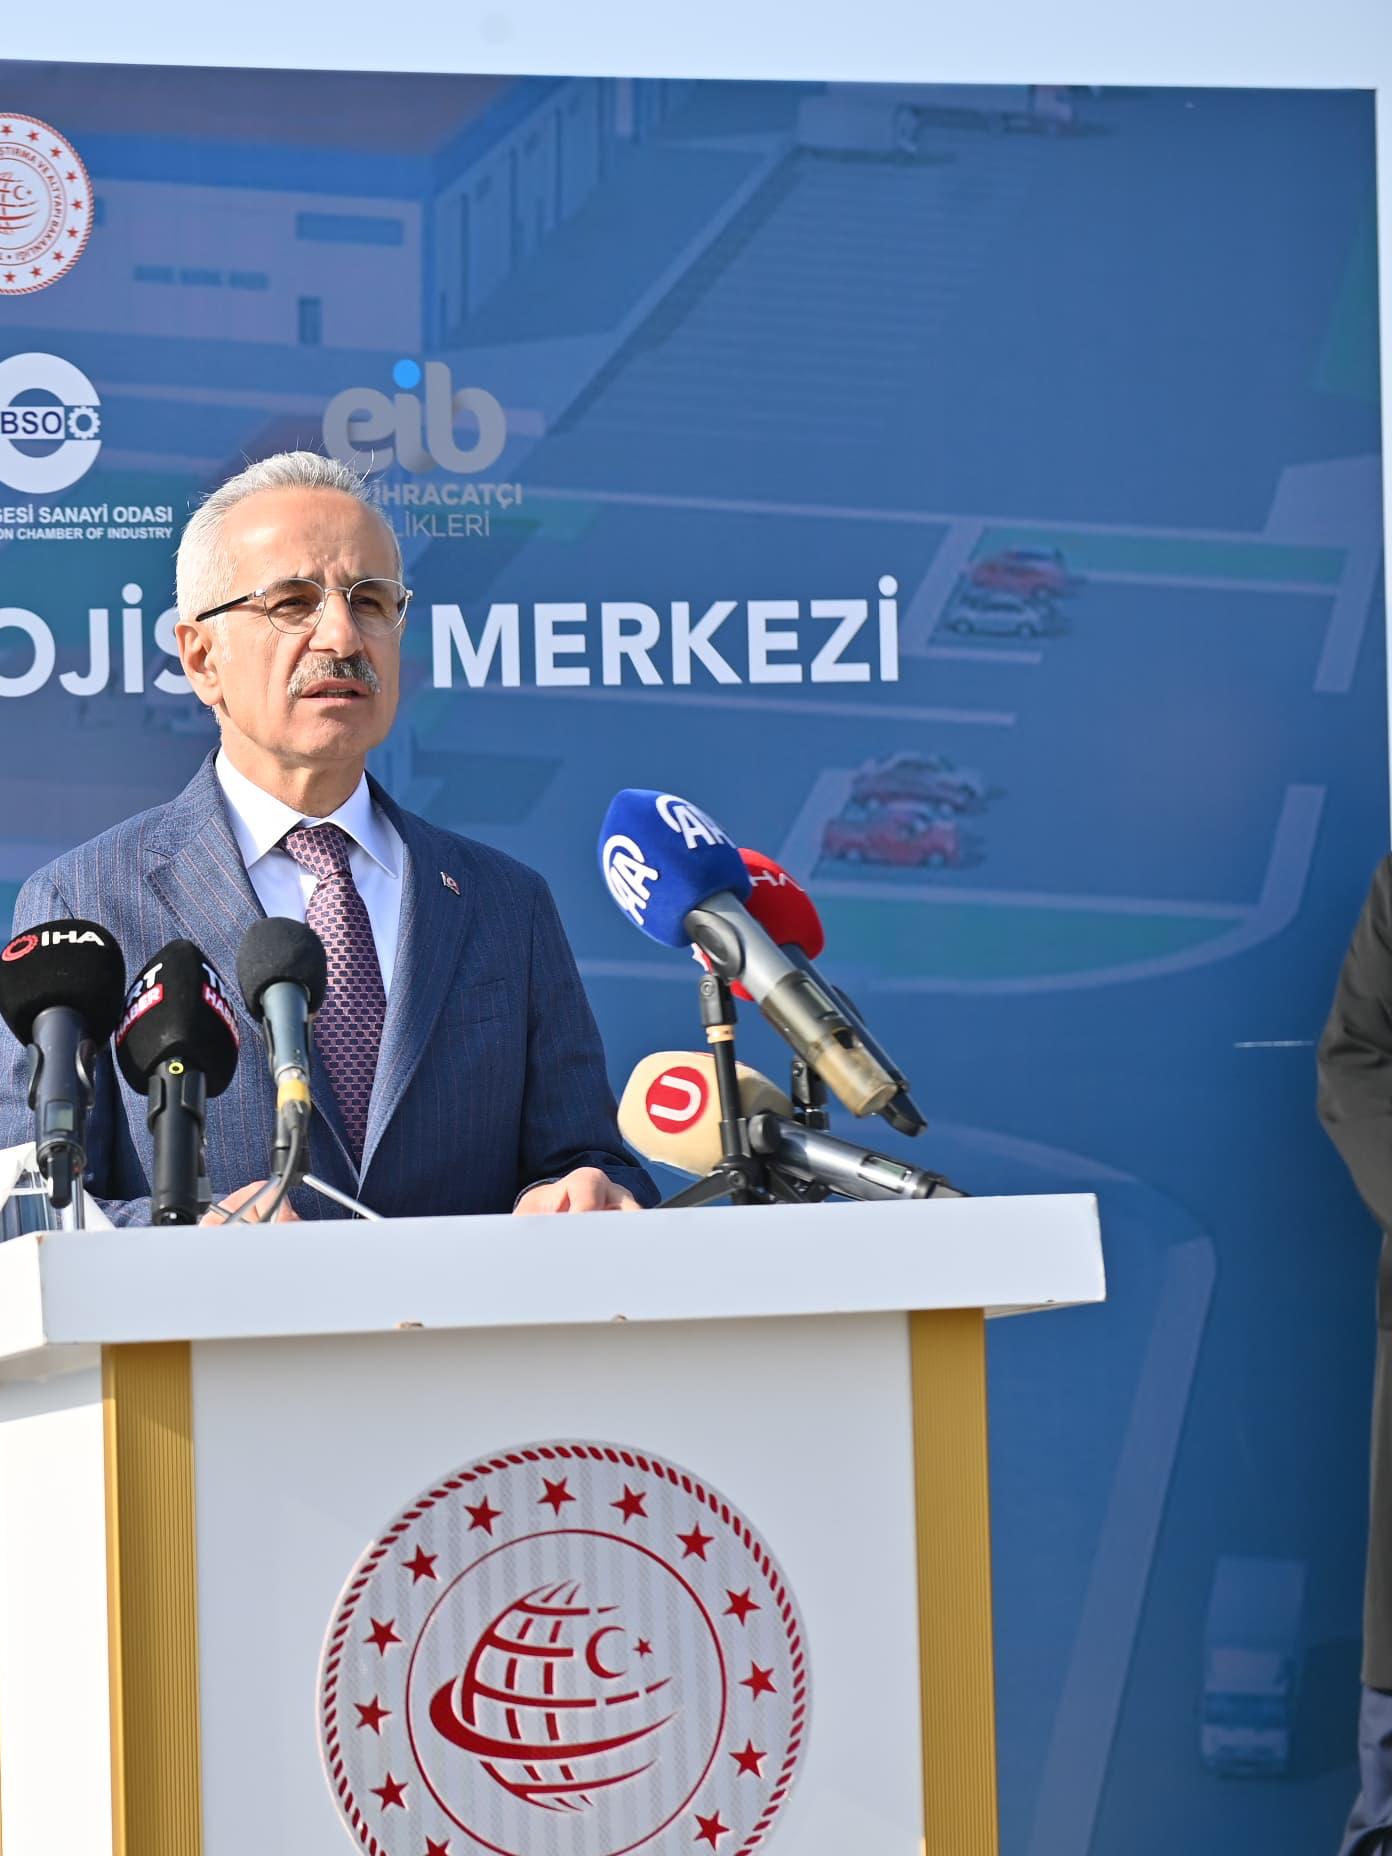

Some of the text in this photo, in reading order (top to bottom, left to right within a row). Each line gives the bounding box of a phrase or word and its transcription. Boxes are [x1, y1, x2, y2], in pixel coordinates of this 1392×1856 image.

[322, 359, 507, 475] eib
[38, 503, 108, 523] SANAYİ
[112, 506, 173, 523] ODASI
[16, 527, 84, 540] CHAMBER
[86, 527, 105, 540] OF
[107, 526, 173, 540] INDUSTRY
[431, 575, 900, 688] MERKEZİ
[749, 869, 806, 892] HA
[649, 1074, 702, 1122] U
